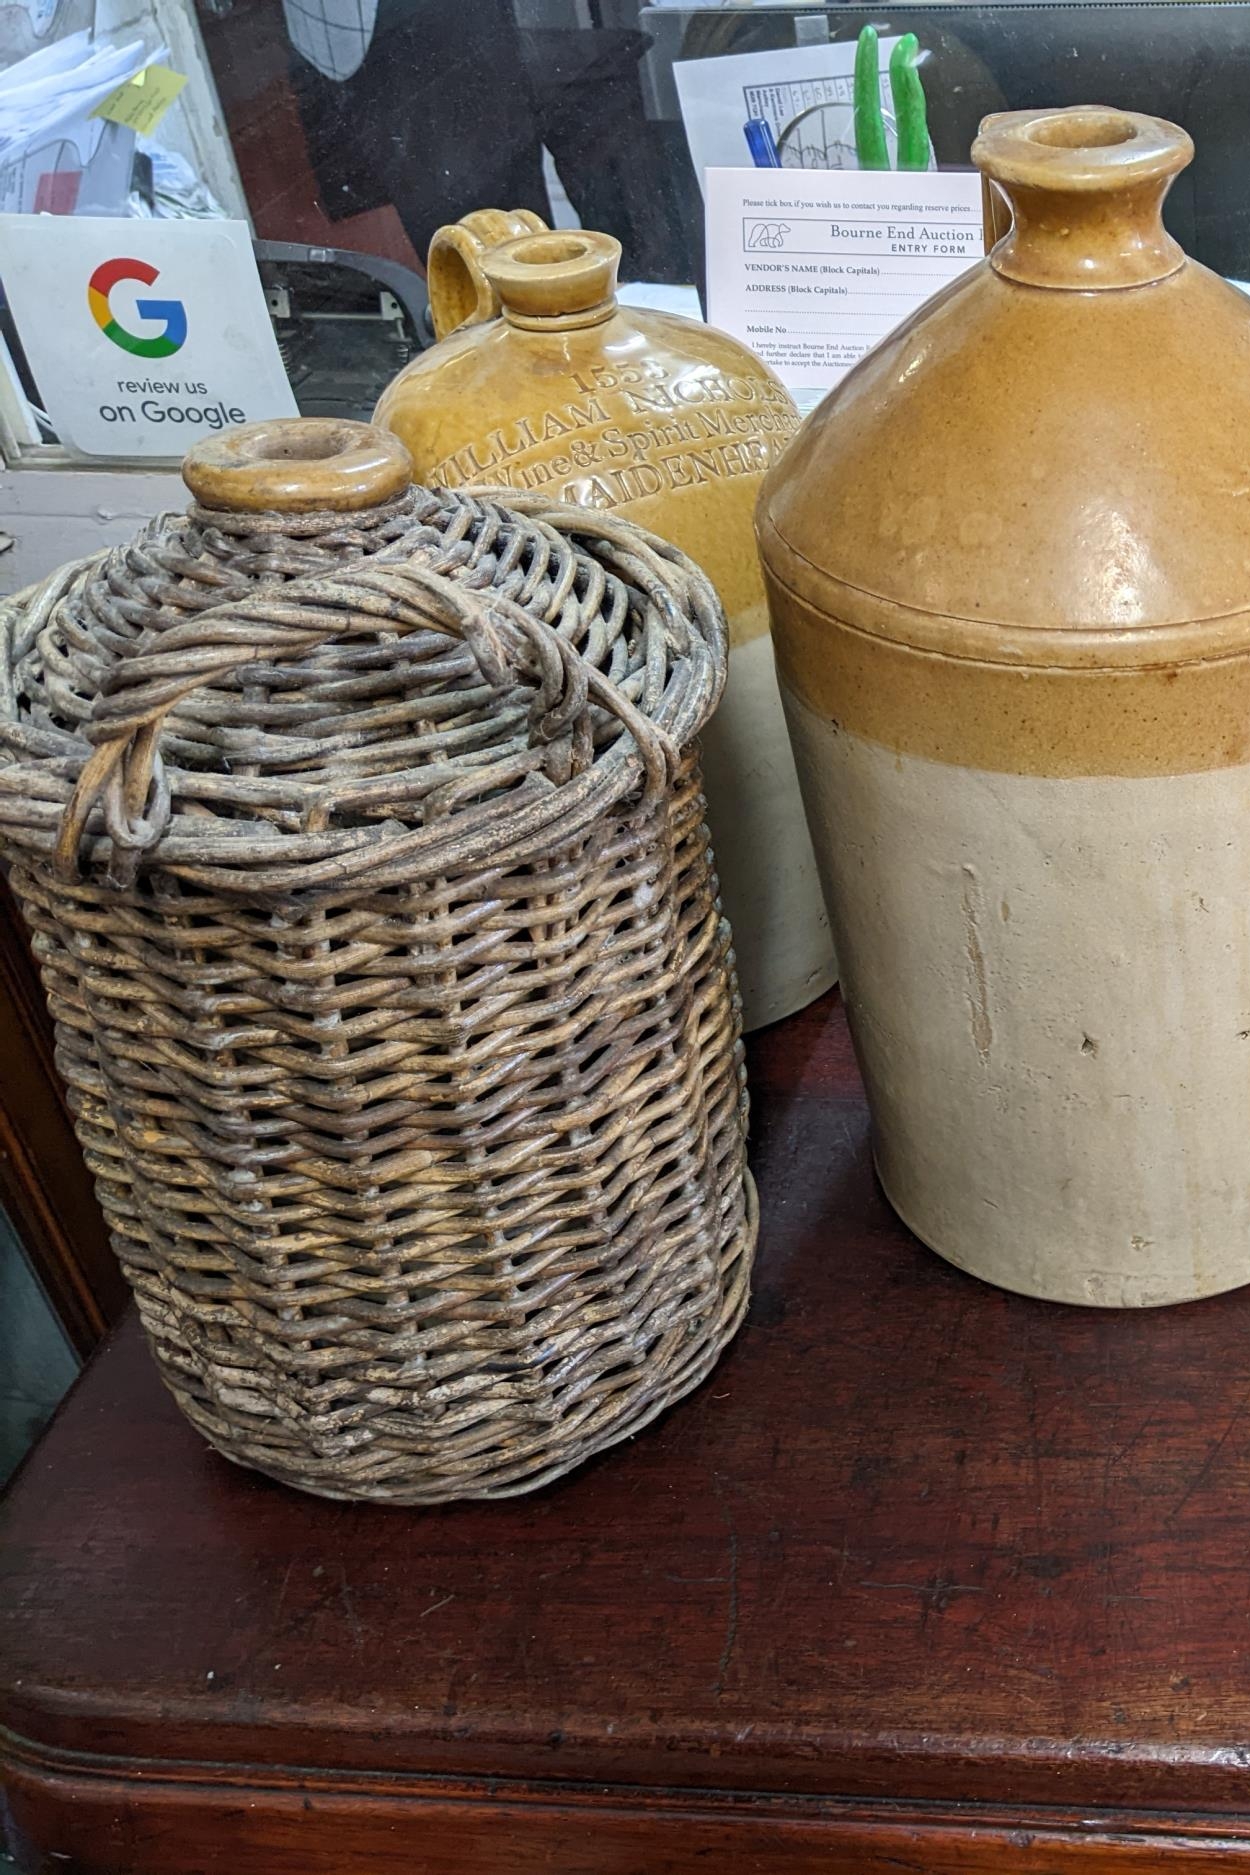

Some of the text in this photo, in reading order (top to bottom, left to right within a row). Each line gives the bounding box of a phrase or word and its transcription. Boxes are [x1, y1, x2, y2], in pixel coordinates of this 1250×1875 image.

[742, 198, 764, 208] Please
[765, 198, 778, 208] tick
[779, 199, 793, 208] box
[794, 199, 801, 208] if
[801, 201, 814, 210] you
[815, 200, 832, 209] wish
[842, 201, 850, 209] to
[850, 202, 876, 210] contact
[877, 203, 890, 212] you
[891, 203, 923, 213] regarding
[925, 204, 950, 212] reserve
[830, 223, 883, 240] Bourne
[887, 225, 915, 240] End
[919, 226, 974, 241] Auction
[891, 243, 966, 254] ENTRY FORM
[791, 265, 819, 274] NAME
[820, 266, 845, 275] (Block
[745, 284, 848, 297] ADDRESS (Block Capitals)
[746, 325, 774, 334] Mobile
[756, 342, 776, 350] hereby
[778, 342, 801, 350] instruct
[803, 342, 825, 351] Bourne
[826, 343, 838, 351] End
[789, 351, 811, 359] declare
[117, 378, 208, 395] review us
[99, 400, 247, 430] on Google
